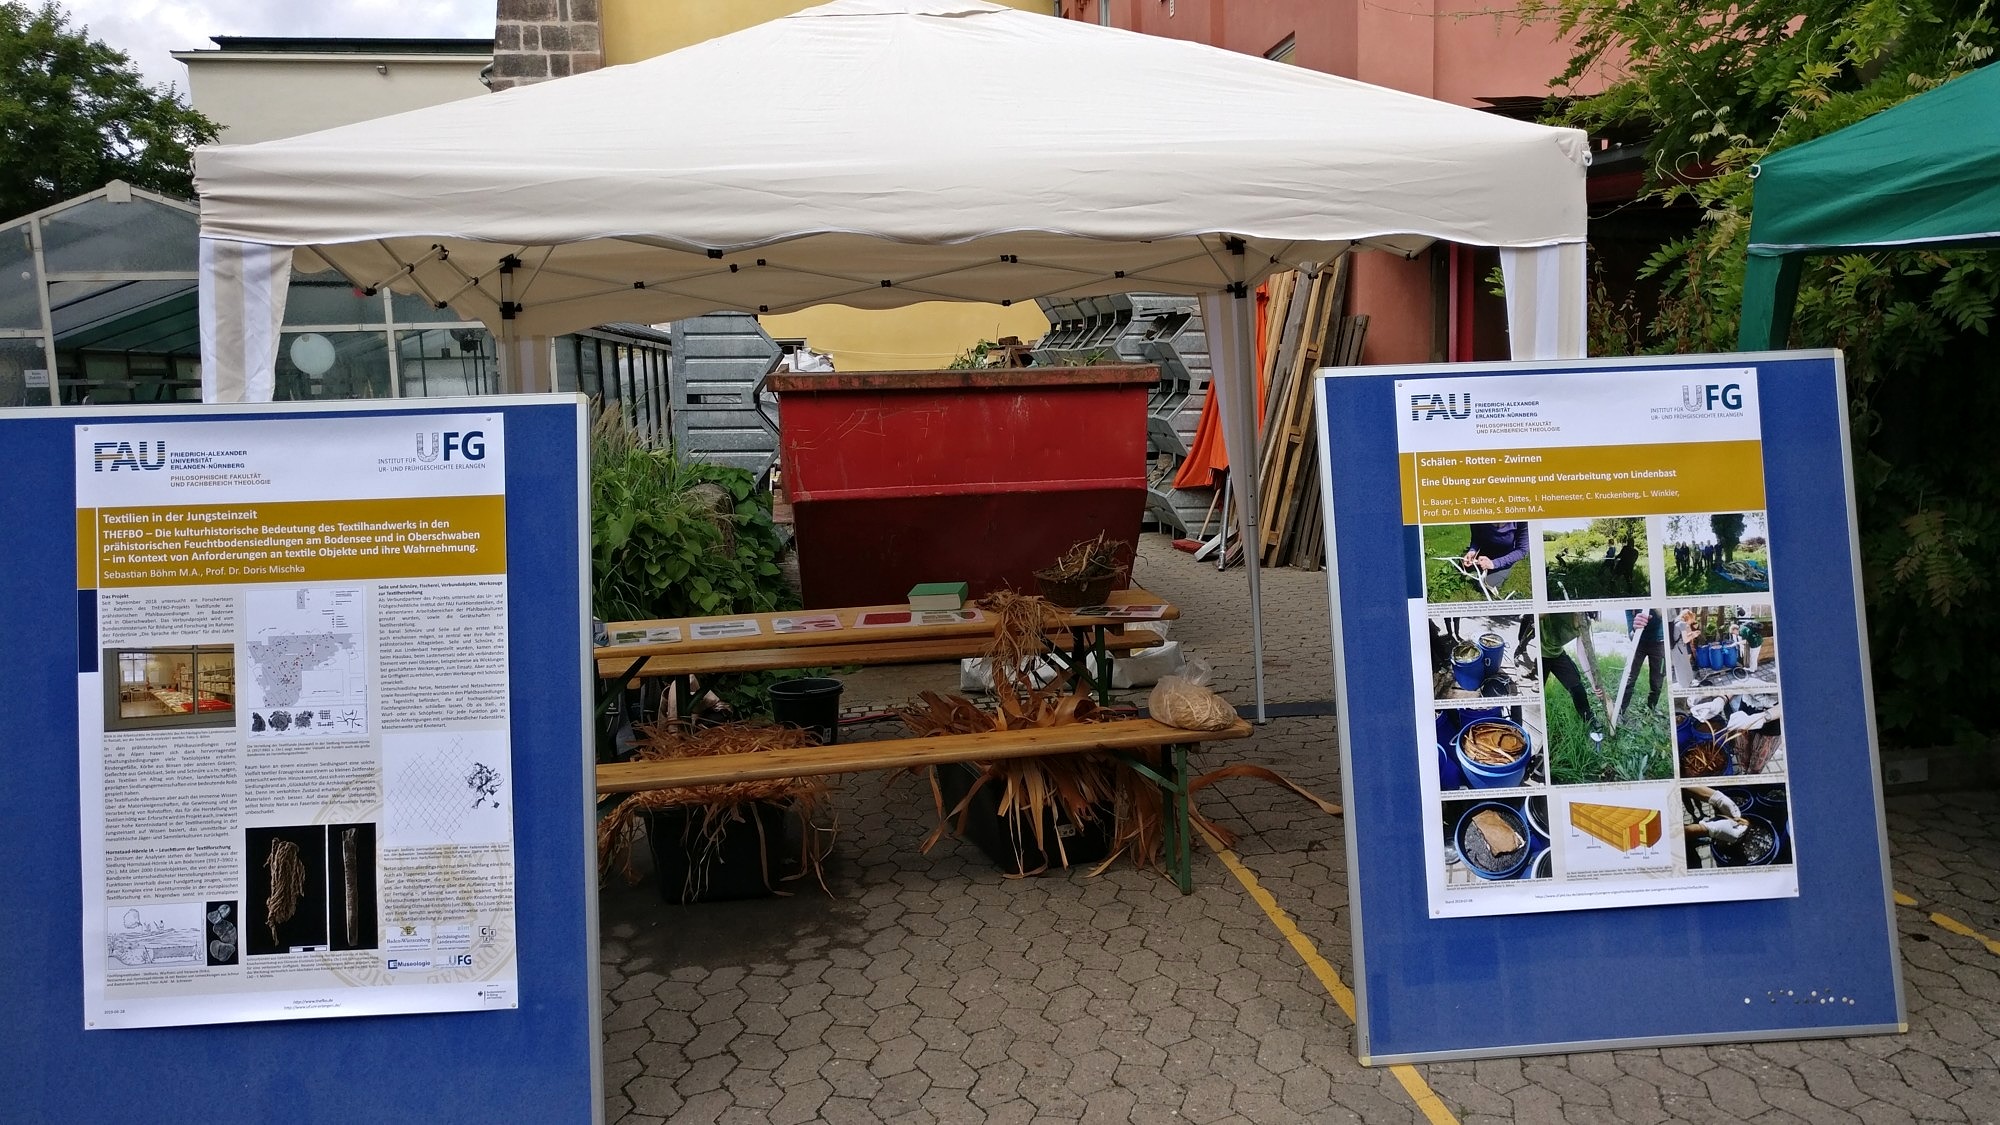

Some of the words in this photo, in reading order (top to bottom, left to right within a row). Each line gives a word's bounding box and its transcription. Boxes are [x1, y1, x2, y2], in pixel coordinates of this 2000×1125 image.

[1682, 384, 1742, 411] UFG
[1411, 393, 1471, 421] FAU
[415, 431, 485, 462] UFG
[95, 441, 165, 472] FAU
[1421, 457, 1457, 466] Schälen
[1465, 456, 1496, 465] Rotten
[1504, 454, 1542, 463] Zwirnen
[1421, 478, 1440, 486] Eine
[1442, 475, 1470, 487] Übung
[1488, 474, 1536, 485] Gewinnung
[1538, 474, 1554, 482] und
[1556, 472, 1612, 482] Verarbeitung
[1630, 469, 1676, 478] Lindenbast
[1430, 498, 1453, 506] Bauer,
[1470, 496, 1497, 504] Bührer,
[1541, 493, 1584, 501] Hohenester,
[1594, 491, 1642, 500] Kruckenberg,
[103, 513, 149, 524] Textilien
[152, 512, 162, 522] in
[165, 512, 184, 522] der
[187, 510, 257, 522] Jungsteinzeit
[1463, 507, 1495, 515] Mischka,
[103, 529, 143, 539] THEFBO
[155, 528, 172, 537] Die
[174, 525, 259, 537] kulturhistorische
[262, 524, 317, 535] Bedeutung
[318, 523, 335, 532] des
[338, 520, 417, 532] Textilhandwerks
[419, 520, 428, 528] in
[431, 520, 449, 528] den
[104, 540, 181, 551] prähistorischen
[184, 536, 303, 549] Feuchtbodensiedlungen
[306, 534, 321, 545] am
[324, 534, 372, 544] Bodensee
[374, 533, 393, 542] und
[396, 533, 405, 542] in
[408, 530, 480, 541] Oberschwaben
[112, 555, 125, 563] im
[128, 553, 168, 563] Kontext
[192, 549, 267, 562] Anforderungen
[285, 548, 316, 558] textile
[318, 547, 357, 558] Objekte
[360, 546, 379, 555] und
[381, 545, 400, 554] ihre
[403, 542, 478, 555] Wahrnehmung.
[104, 570, 147, 579] Sebastian
[149, 569, 176, 577] Böhm
[179, 568, 202, 577] M.A.,
[206, 567, 225, 575] Prof.
[244, 566, 266, 574] Doris
[268, 564, 305, 574] Mischka
[449, 955, 472, 965] UFG
